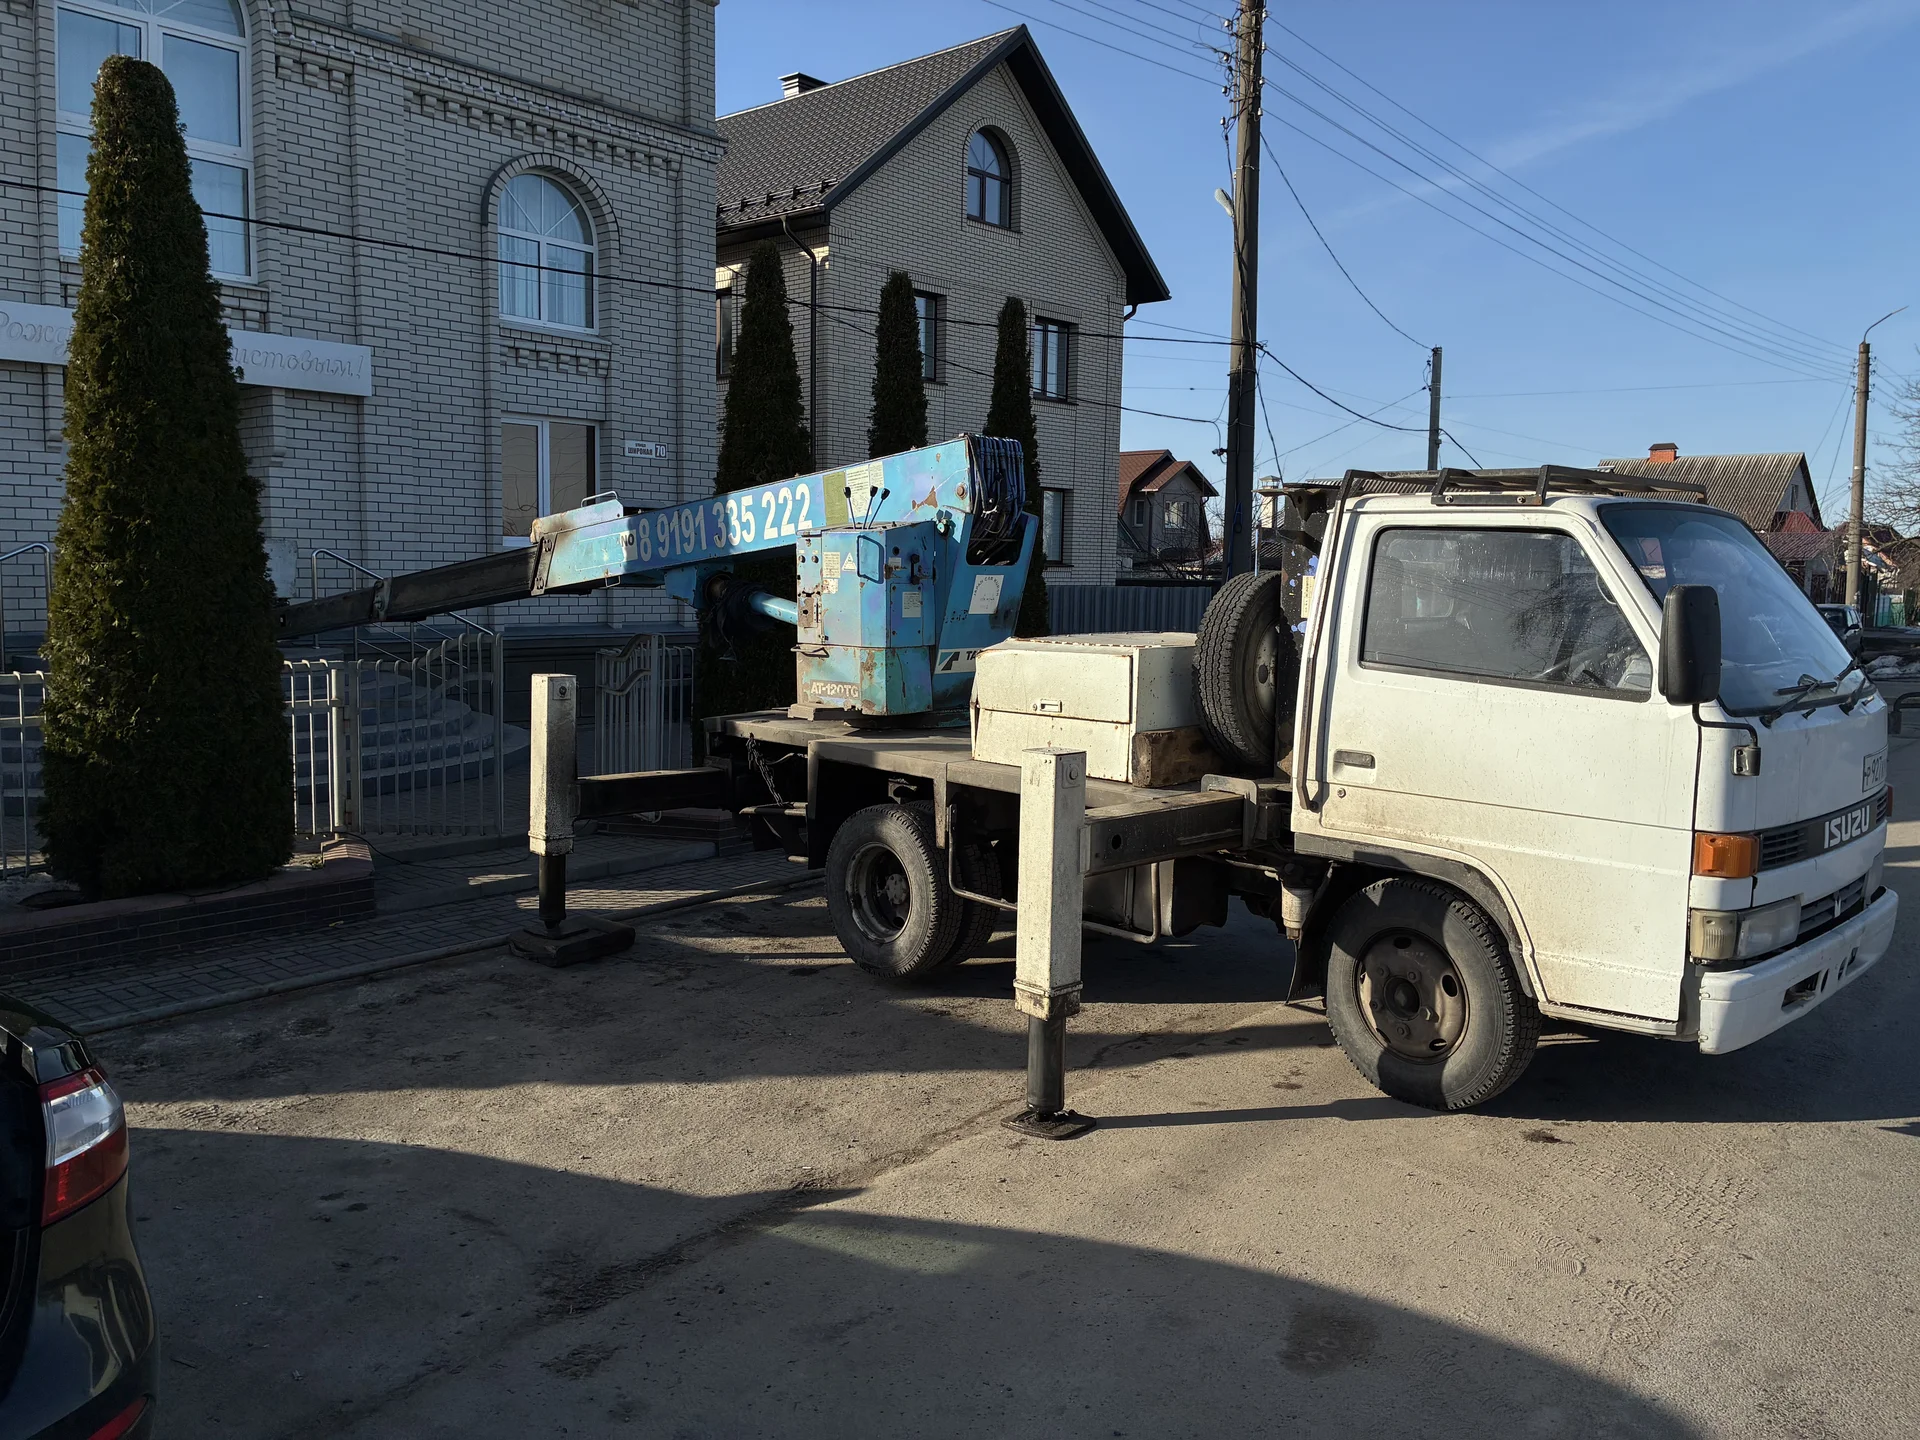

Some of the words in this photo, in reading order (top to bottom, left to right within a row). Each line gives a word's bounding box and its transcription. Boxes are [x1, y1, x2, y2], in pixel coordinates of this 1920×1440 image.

[232, 346, 364, 380] истовым!
[628, 447, 653, 456] ШИРОКАЯ
[655, 445, 666, 457] 70
[638, 517, 652, 562] 8
[656, 504, 707, 559] 9191
[711, 494, 757, 549] 335
[761, 482, 813, 541] 222
[1823, 804, 1870, 849] ISUZU
